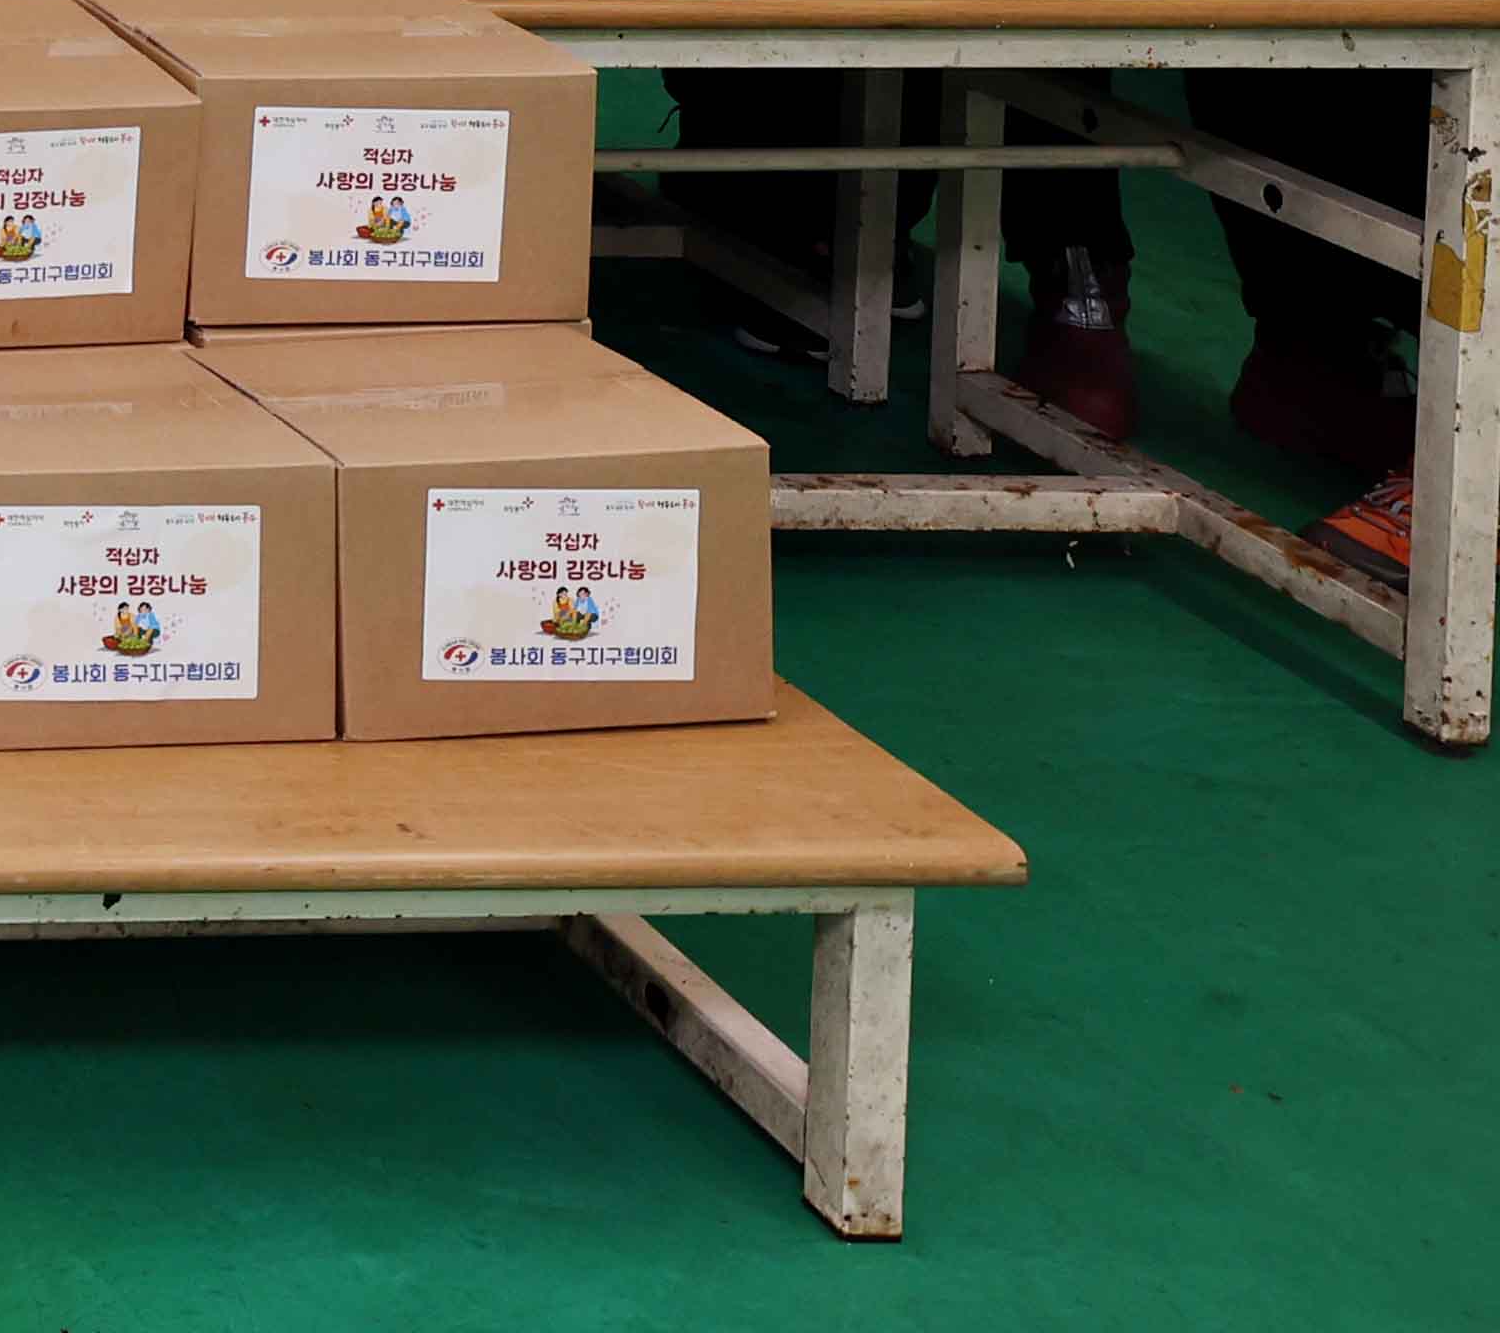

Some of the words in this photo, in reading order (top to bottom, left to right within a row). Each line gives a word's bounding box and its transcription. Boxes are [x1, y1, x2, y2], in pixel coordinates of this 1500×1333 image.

[361, 148, 415, 166] 적십자
[315, 170, 375, 192] 사랑의
[379, 172, 459, 194] 김장나눔
[544, 532, 601, 552] 적십자
[105, 546, 161, 568] 적십자
[495, 559, 559, 581] 사랑의
[564, 559, 648, 582] 김장나눔
[56, 574, 120, 598] 사랑의
[126, 574, 209, 598] 김장나눔
[489, 645, 545, 667] 봉사회
[549, 645, 681, 668] 동구지구협의회
[52, 662, 108, 684] 봉사회
[112, 660, 243, 684] 동구지구협의회
